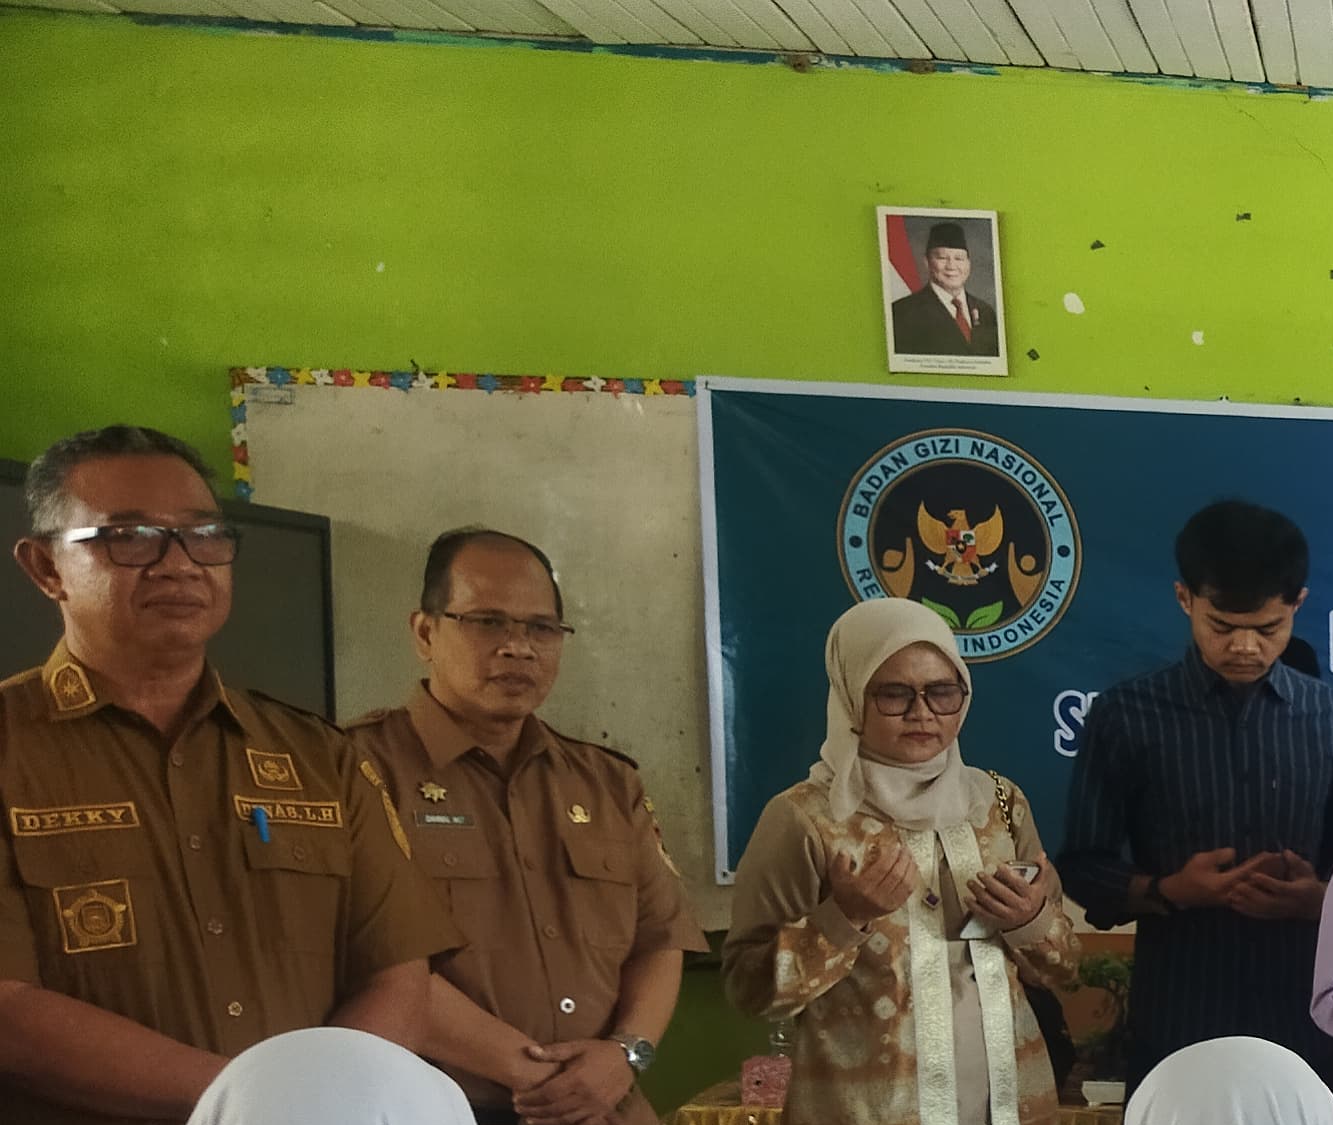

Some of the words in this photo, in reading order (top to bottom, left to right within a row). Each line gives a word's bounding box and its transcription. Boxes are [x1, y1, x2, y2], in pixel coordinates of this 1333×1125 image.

[853, 452, 909, 518] BADAN
[914, 438, 960, 458] GIZI
[970, 440, 1063, 528] NASIONAL
[963, 578, 1065, 653] INDONESIA
[21, 808, 126, 830] DEKKY
